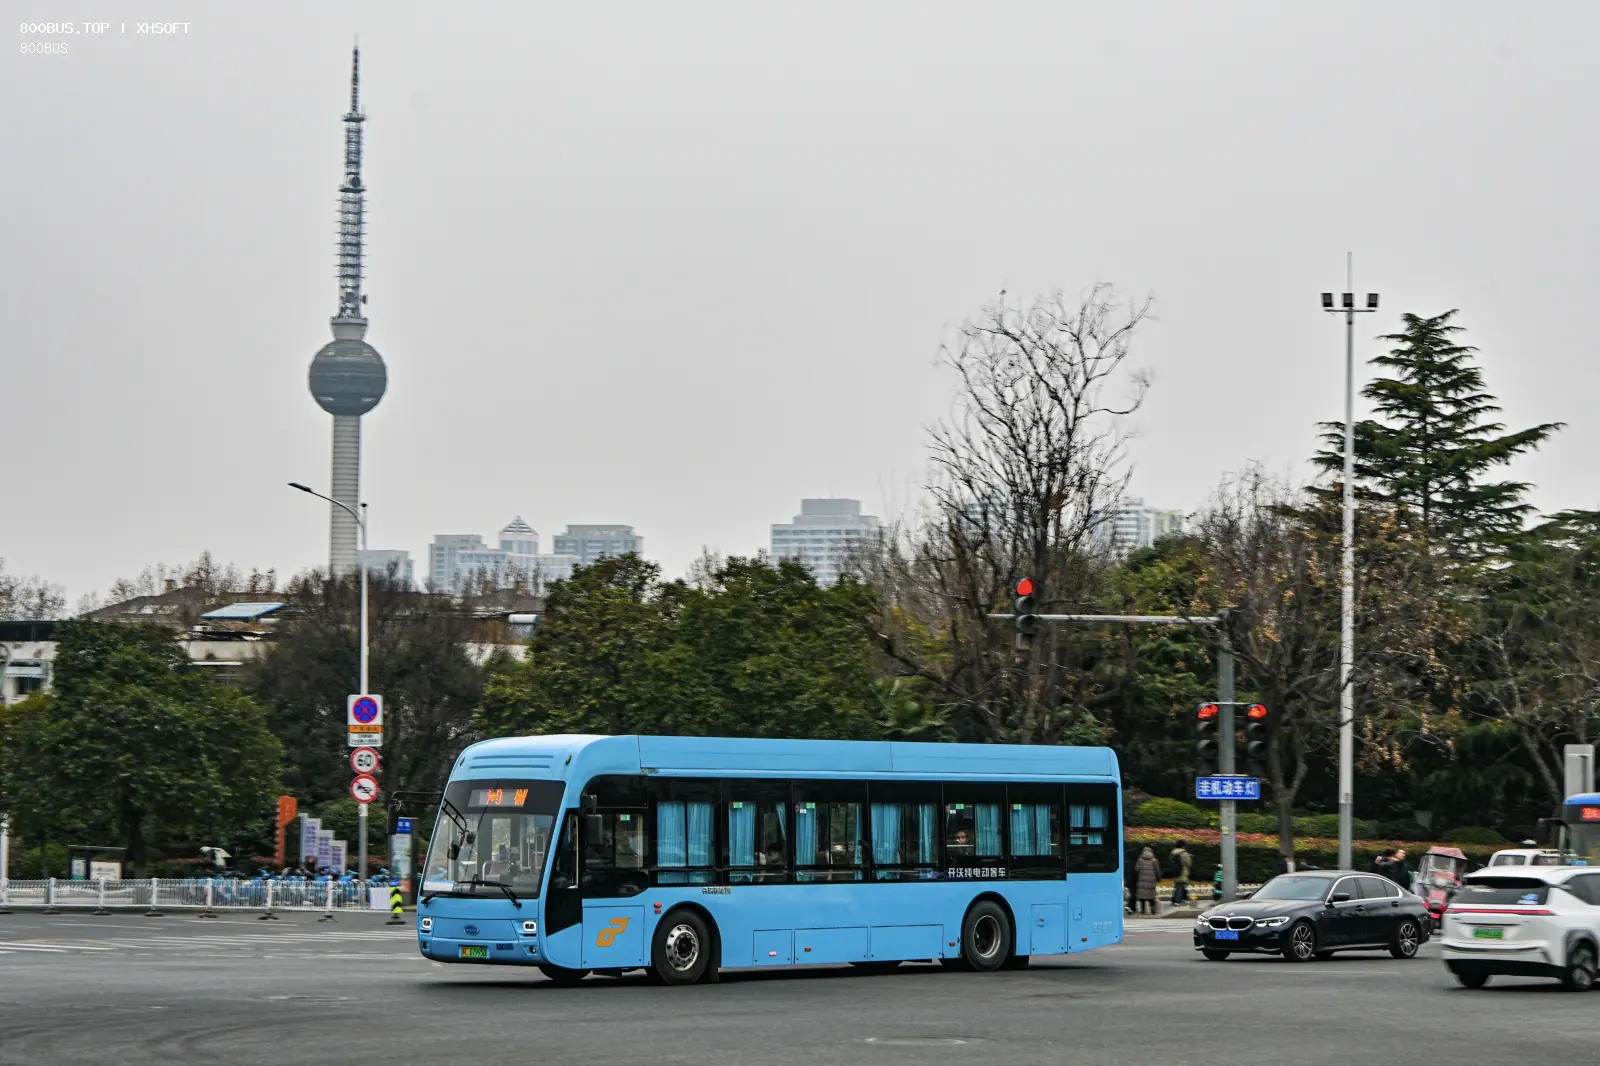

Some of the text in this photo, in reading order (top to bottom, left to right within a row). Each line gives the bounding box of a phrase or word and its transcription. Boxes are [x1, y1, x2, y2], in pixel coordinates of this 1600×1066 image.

[357, 754, 372, 767] 60
[1199, 780, 1257, 795] 非机动车灯
[947, 867, 1006, 878] 开沃纯电动客车
